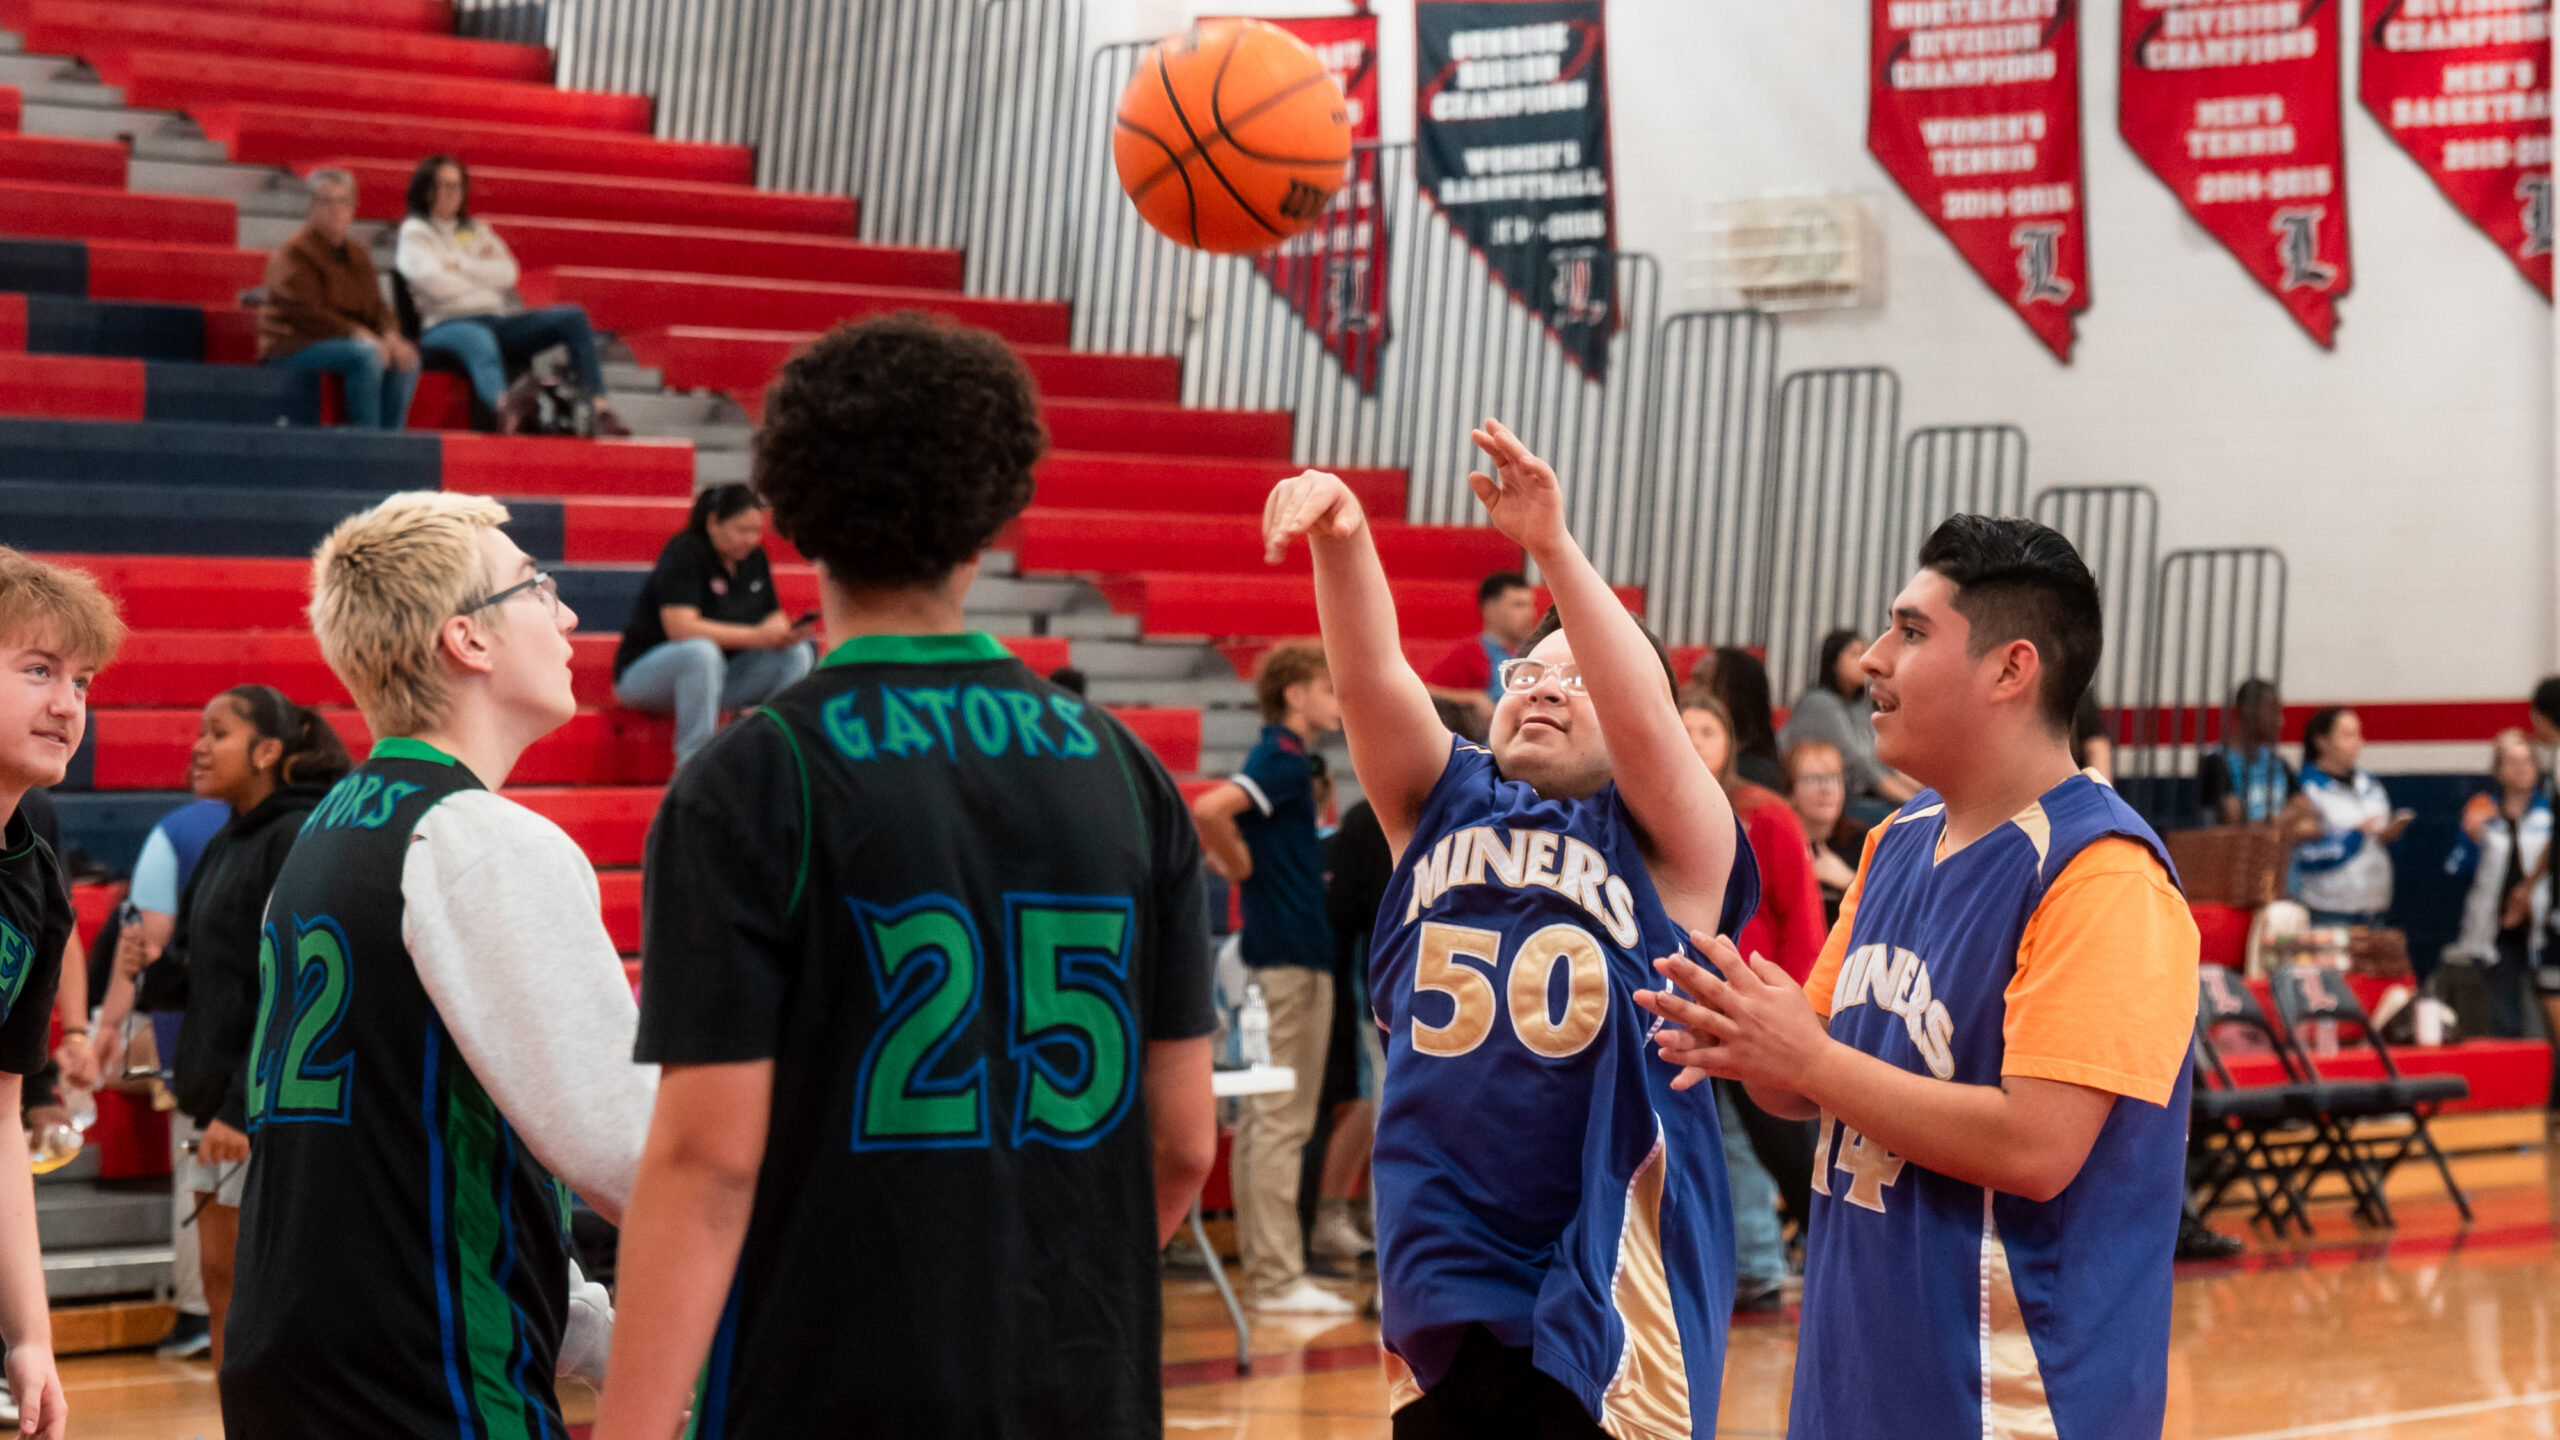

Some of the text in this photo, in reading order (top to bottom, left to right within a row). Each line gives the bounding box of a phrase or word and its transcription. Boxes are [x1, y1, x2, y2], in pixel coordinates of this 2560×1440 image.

[1890, 0, 2056, 28] NORTHEAST
[2164, 1, 2299, 36] DIVISION
[1910, 23, 2041, 57] DIVISION
[2145, 29, 2315, 69] CHAMPIONS
[1892, 52, 2055, 89] CHAMPIONS
[2444, 61, 2533, 92] MEN'S
[1433, 81, 1586, 120] CHAMPIONS
[2196, 94, 2282, 126] MEN'S
[1920, 112, 2045, 146] WOMEN'S
[2188, 124, 2294, 158] TENNIS
[1465, 141, 1579, 175] WOMEN'S
[1930, 144, 2035, 176] TENNIS
[1442, 168, 1604, 204] BASKETBALL
[1944, 182, 2073, 219] 2014-2015
[2198, 164, 2331, 203] 2014-2015
[821, 684, 1098, 763] GATORS
[1402, 825, 1639, 949] MINERS
[1411, 921, 1609, 1058] 50
[246, 914, 355, 1132] 22
[846, 892, 1144, 1152] 25
[1811, 1105, 1906, 1213] 14
